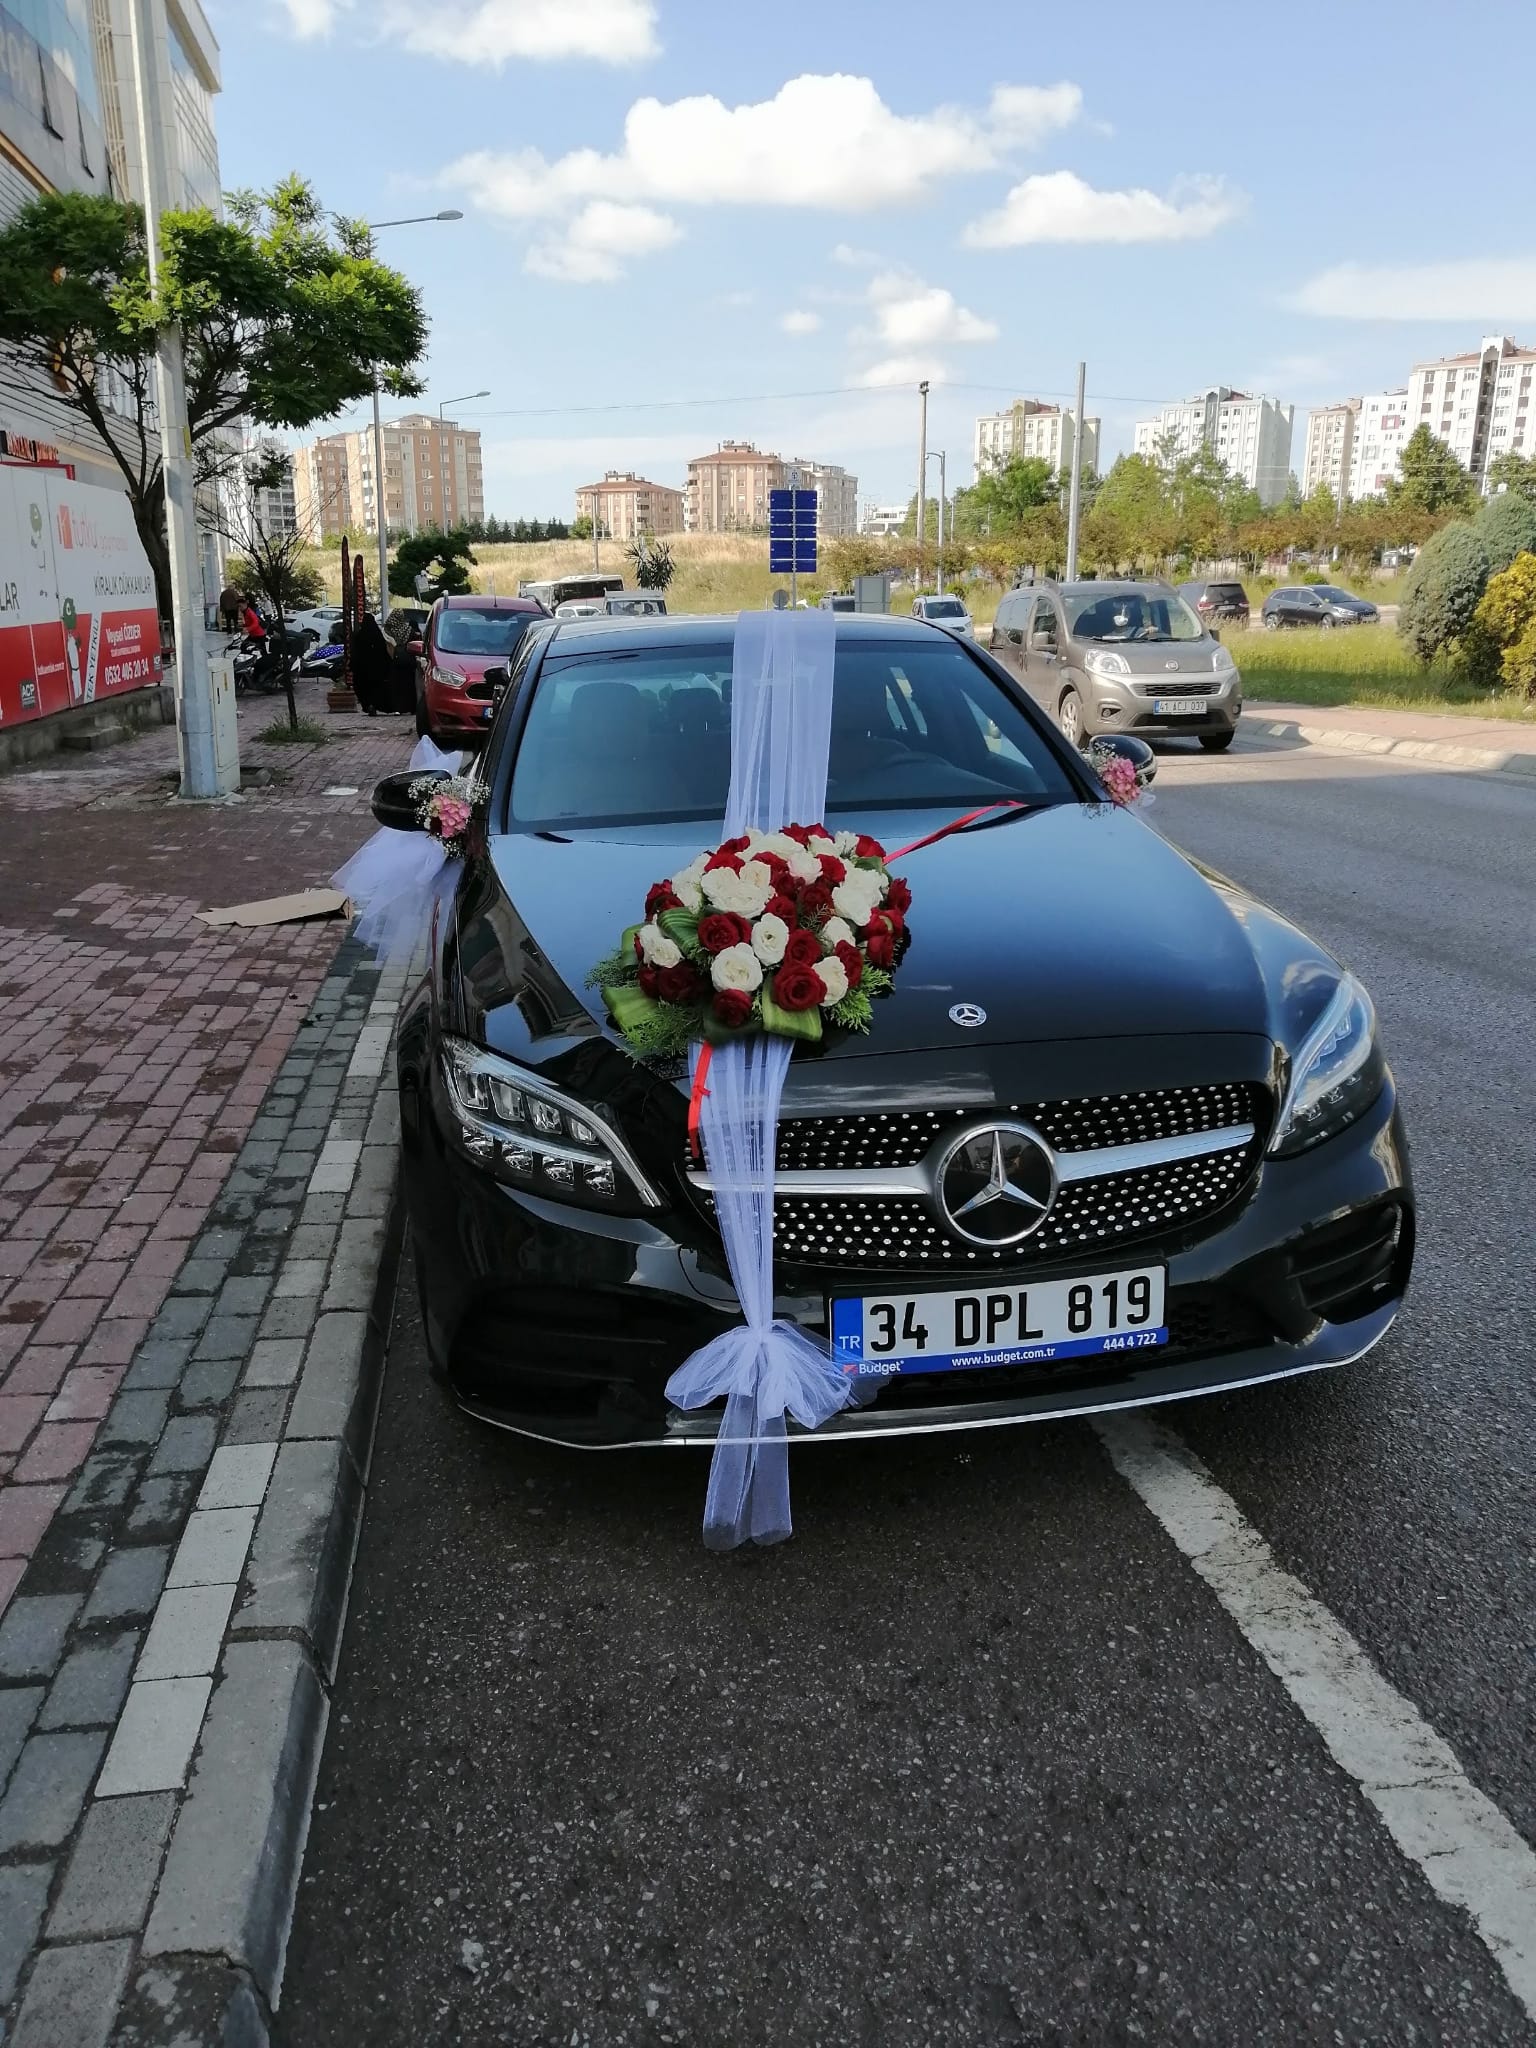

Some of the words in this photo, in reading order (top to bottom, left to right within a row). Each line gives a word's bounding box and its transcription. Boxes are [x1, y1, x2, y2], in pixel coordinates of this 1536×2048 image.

[105, 664, 121, 686] 0532
[869, 1301, 929, 1353] 34
[953, 1291, 1044, 1348] DPL
[1067, 1275, 1152, 1334] 819
[839, 1335, 861, 1350] TR
[1103, 1337, 1126, 1350] 444
[1126, 1335, 1135, 1347] 4
[1136, 1332, 1158, 1346] 722
[951, 1347, 1056, 1367] www.budget.com.tr
[858, 1361, 901, 1376] Budget
